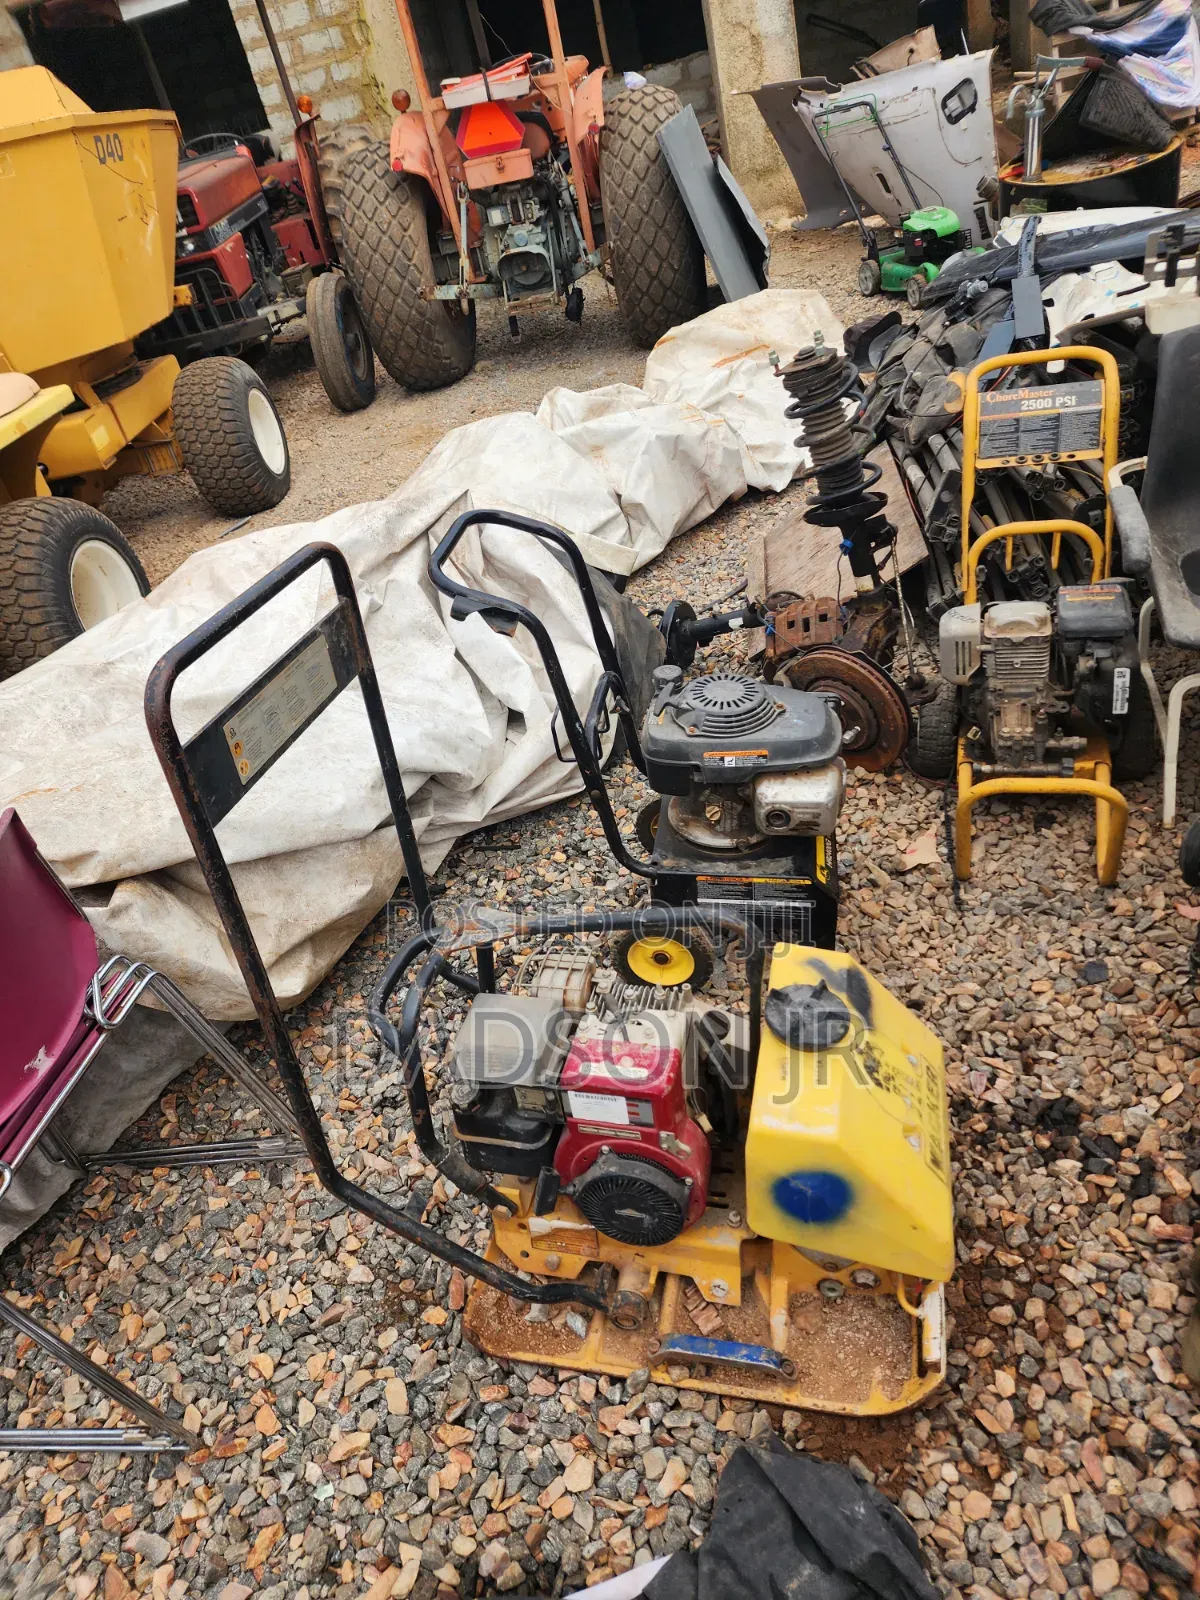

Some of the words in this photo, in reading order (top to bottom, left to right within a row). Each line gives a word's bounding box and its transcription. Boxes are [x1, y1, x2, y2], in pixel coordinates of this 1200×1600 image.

[93, 133, 124, 165] D40
[986, 388, 1055, 403] ChoreMaster
[1020, 397, 1052, 411] 2500
[1055, 395, 1077, 407] PSI
